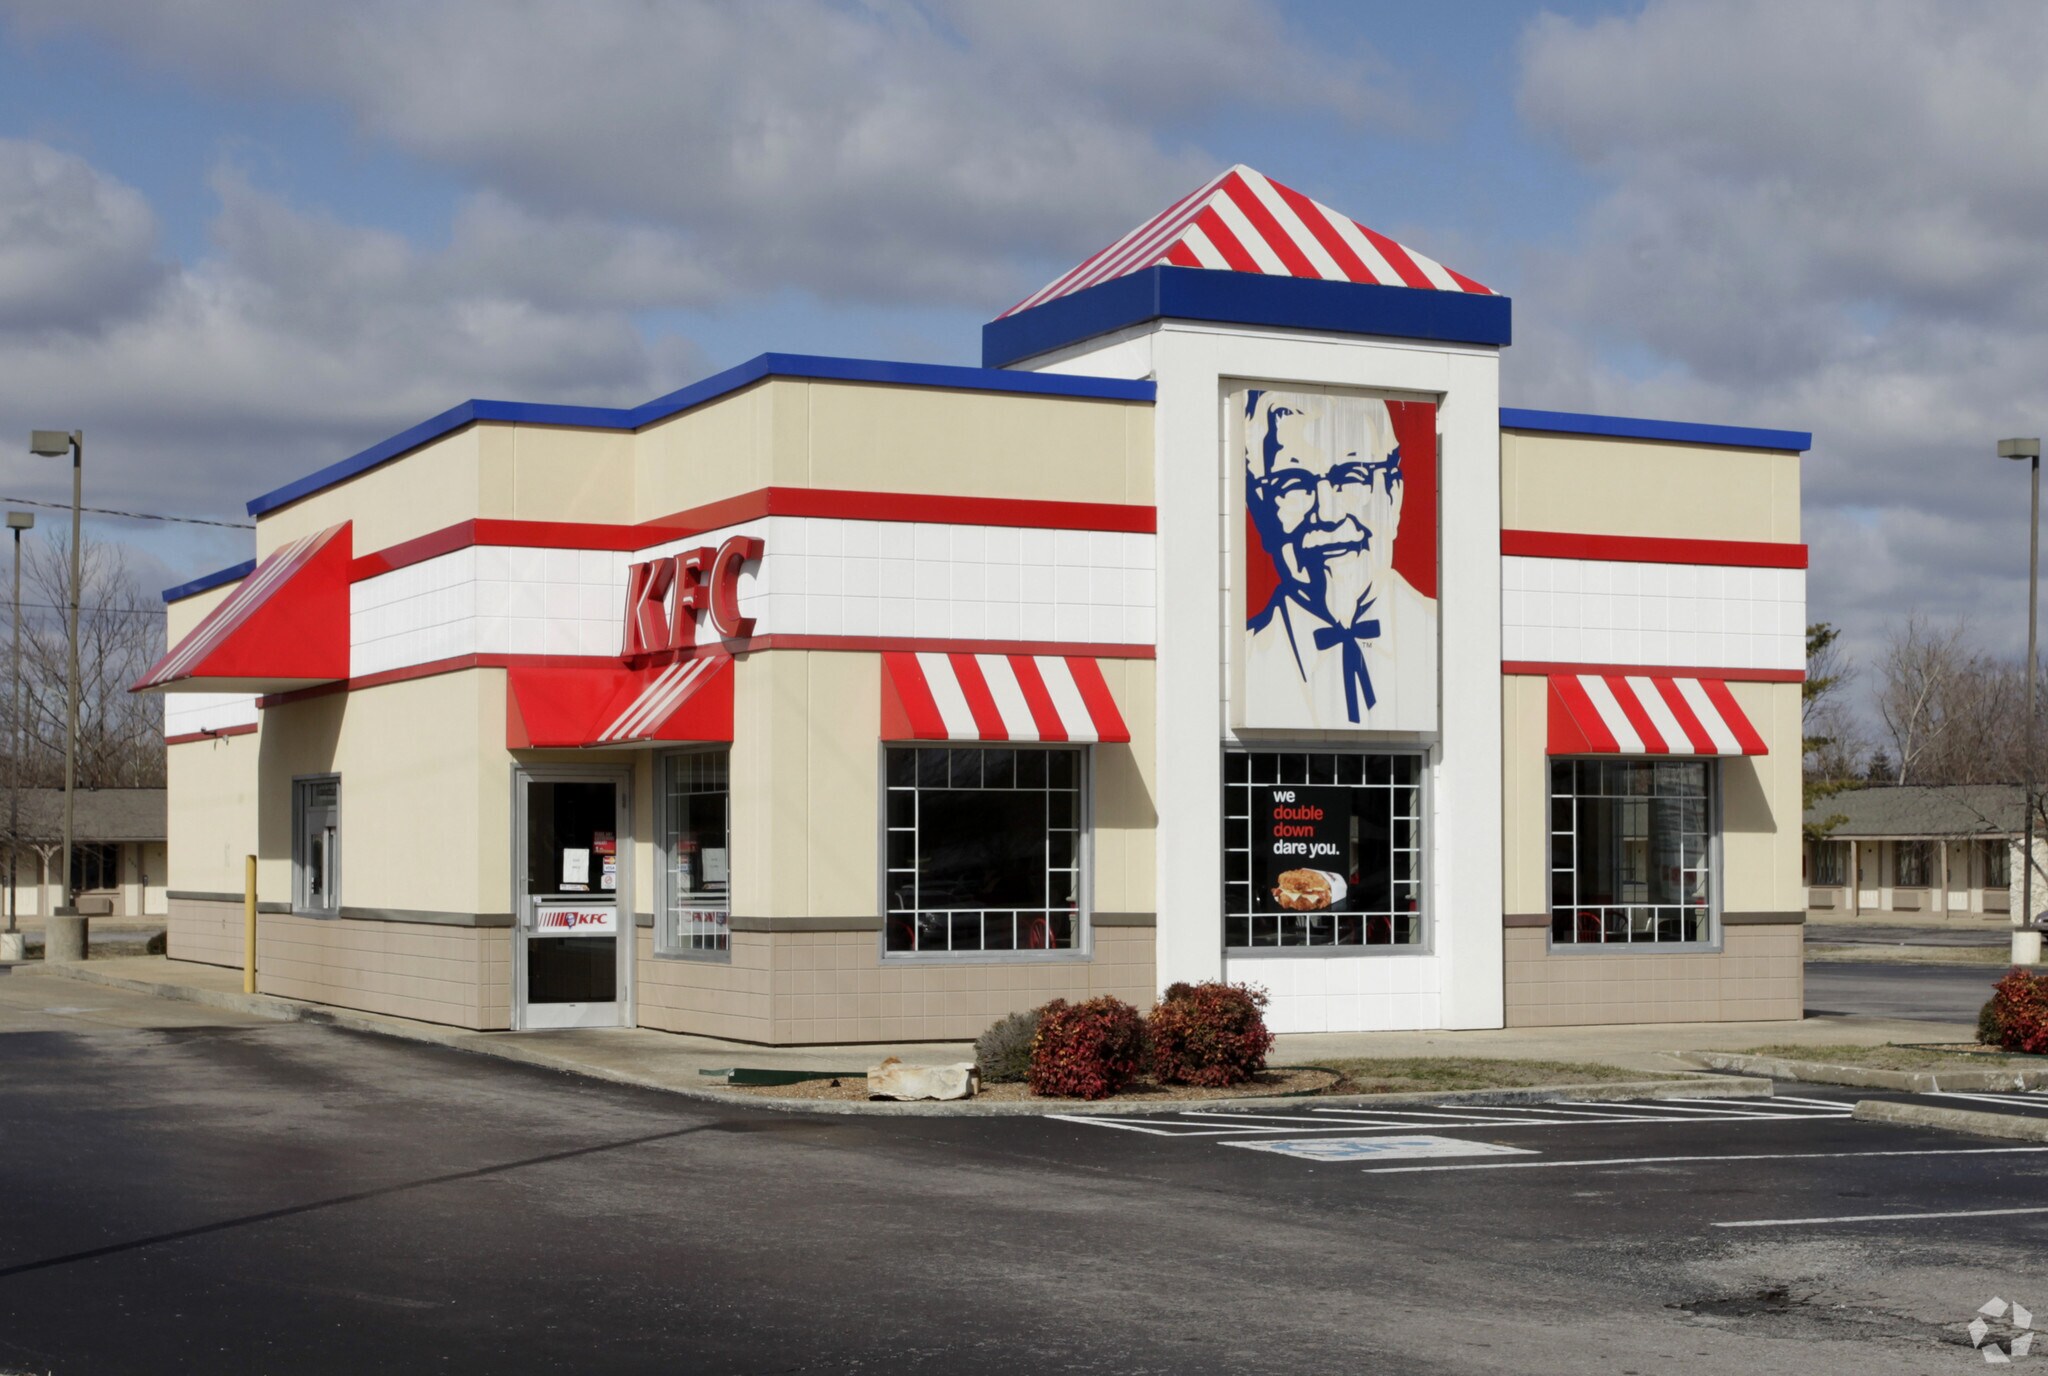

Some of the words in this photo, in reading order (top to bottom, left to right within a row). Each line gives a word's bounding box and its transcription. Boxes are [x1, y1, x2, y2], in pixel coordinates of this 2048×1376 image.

[621, 535, 765, 656] KFC
[1273, 790, 1296, 803] we
[1273, 804, 1324, 820] double
[1273, 821, 1314, 837] down
[1273, 838, 1307, 855] dare
[1308, 842, 1340, 859] you.
[578, 913, 608, 925] KFC
